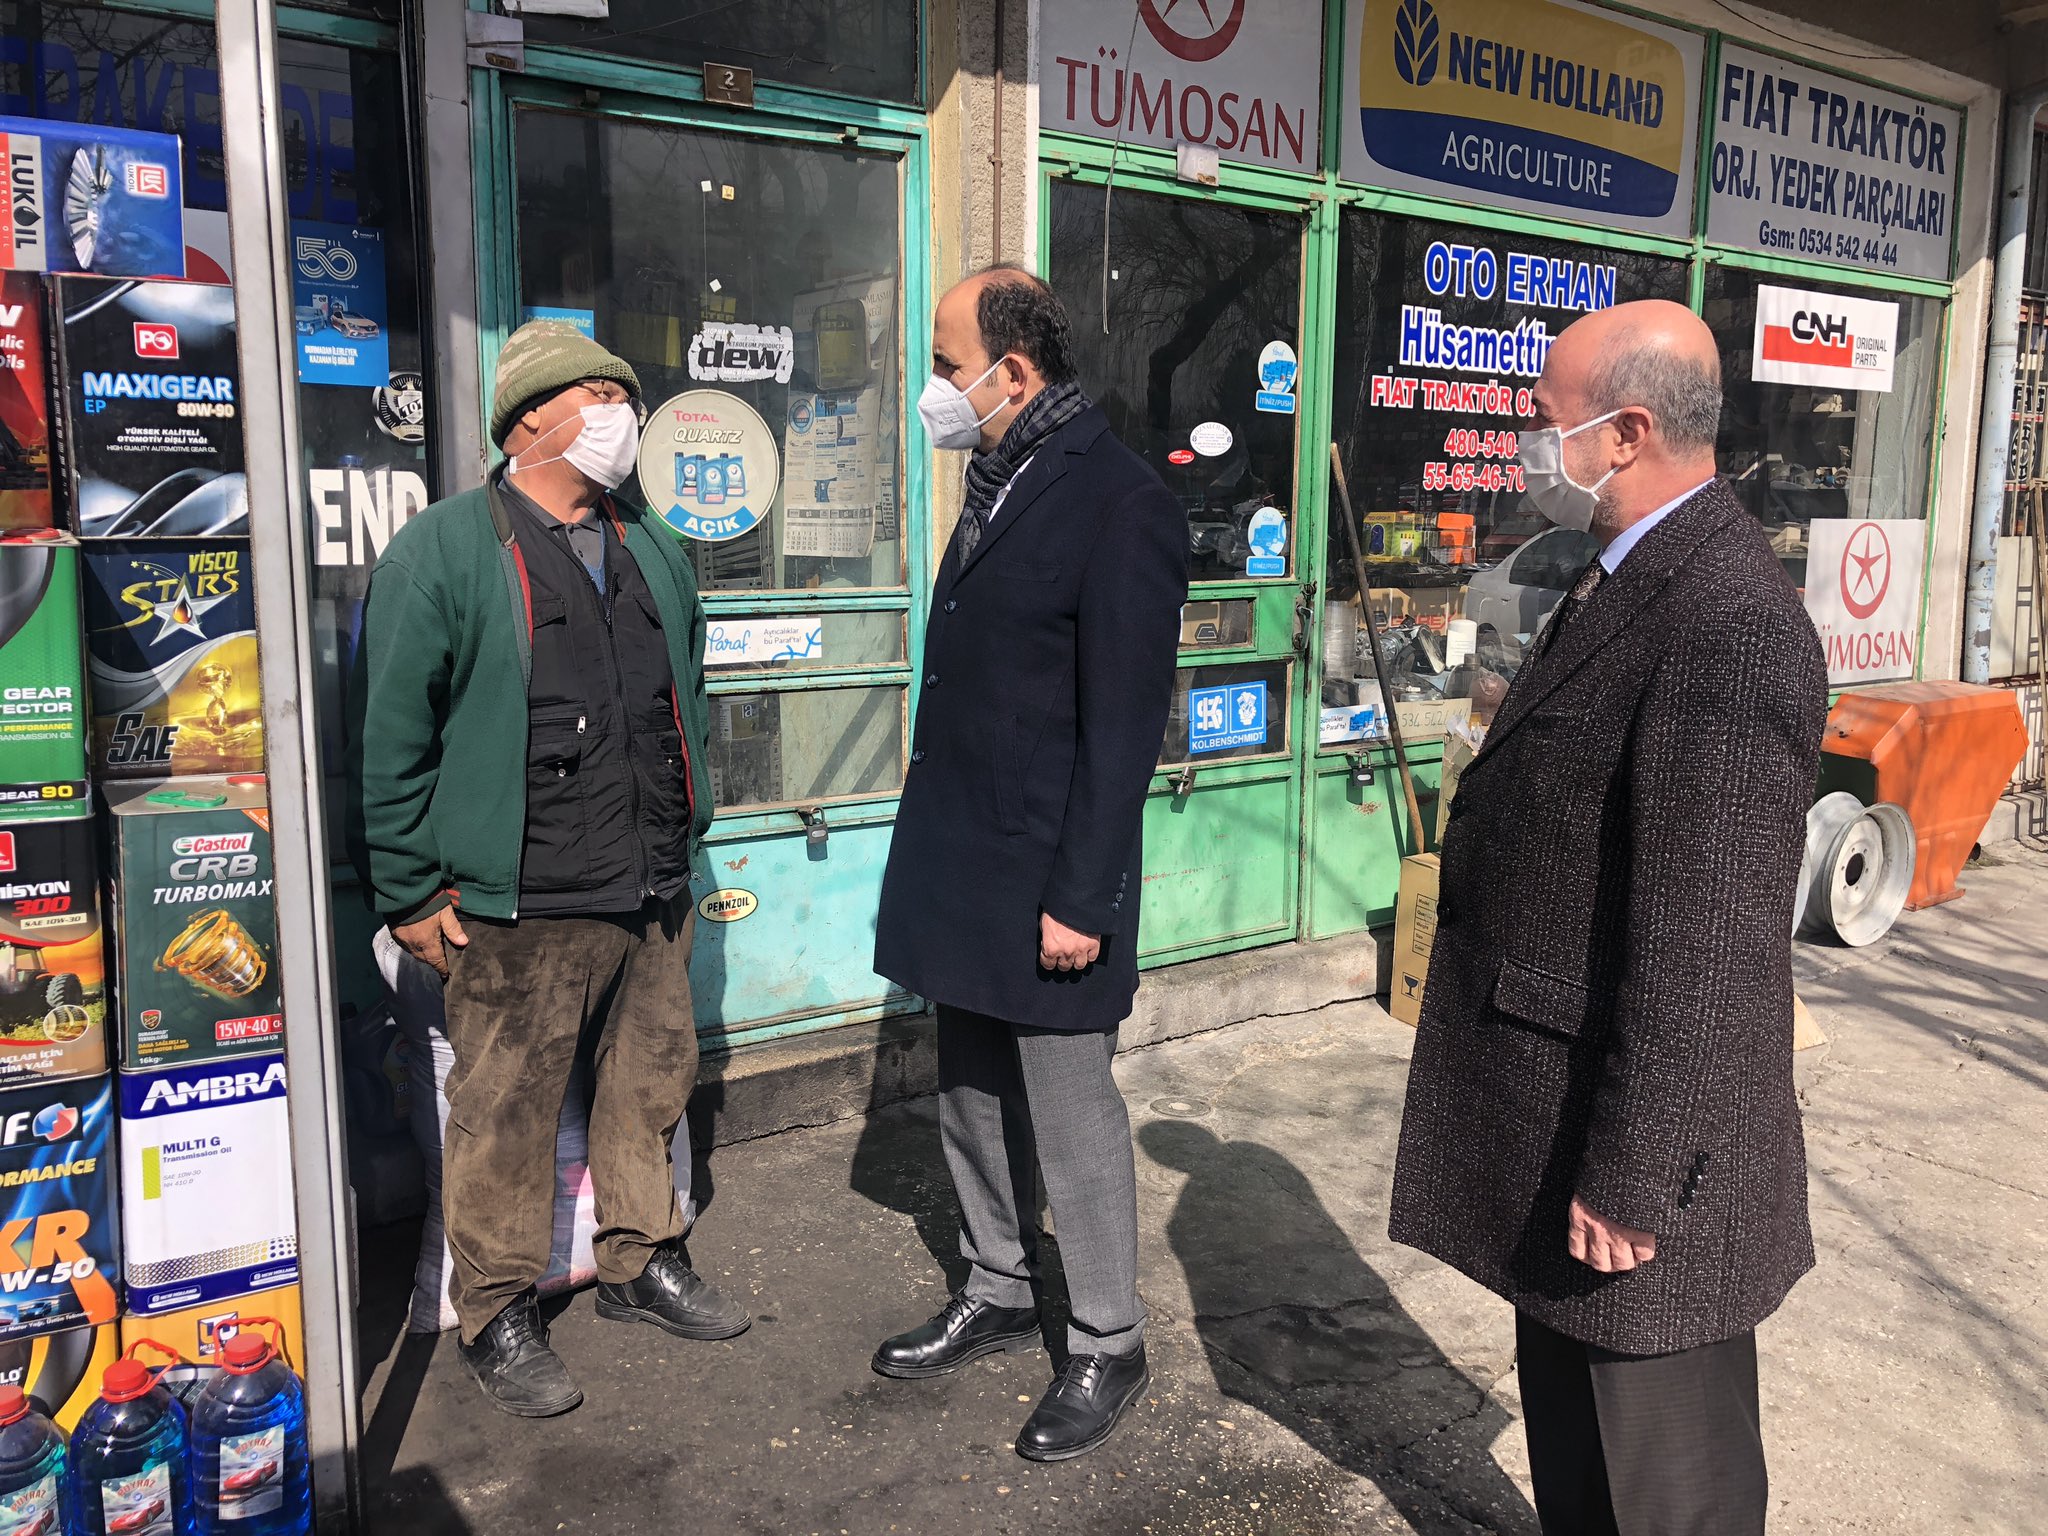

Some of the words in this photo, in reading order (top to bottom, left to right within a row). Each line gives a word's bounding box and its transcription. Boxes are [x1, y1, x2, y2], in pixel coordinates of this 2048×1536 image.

[725, 71, 735, 86] 2
[1449, 31, 1525, 96] NEW
[1530, 52, 1664, 129] HOLLAND
[1056, 46, 1305, 164] TÜMOSAN
[1722, 64, 1799, 136] FIAT
[1808, 86, 1947, 175] TRAKTÖR
[1442, 131, 1612, 198] AGRICULTURE
[1712, 141, 1761, 201] ORJ.
[1770, 153, 1839, 216] YEDEK
[1842, 170, 1946, 238] PARÇALARI
[11, 153, 42, 250] LUKOIL
[1759, 220, 1795, 250] Gsm:
[1799, 227, 1832, 256] 0534
[1835, 234, 1860, 259] 542
[1863, 239, 1879, 264] 44
[1882, 243, 1898, 267] 44
[1425, 242, 1496, 299] OTO
[1506, 252, 1616, 312] ERHAN
[1792, 311, 1847, 344] CNH
[1856, 336, 1888, 353] ORIGINAL
[698, 341, 782, 370] dew
[1855, 353, 1878, 367] PARTS
[82, 372, 234, 401] MAXIGEAR
[1371, 375, 1418, 409] FIAT
[1420, 380, 1512, 416] TRAKTÖR
[85, 400, 107, 413] EP
[177, 402, 235, 418] 80W-90
[673, 410, 720, 424] TOTAL
[674, 427, 744, 445] QUARTZ
[683, 516, 741, 537] AÇIK
[1819, 624, 1914, 672] ÜMOSAN
[4, 687, 72, 700] GEAR
[0, 702, 73, 714] ECTOR
[0, 733, 58, 741] ANSMISSION
[4, 723, 73, 732] PERFORMANCE
[107, 713, 179, 764] SAE
[1192, 731, 1264, 751] KOLBENSCHMIDT
[42, 786, 73, 798] 90
[193, 835, 248, 853] Castrol
[169, 854, 258, 881] CRB
[153, 880, 272, 905] TURBOMAX
[12, 896, 72, 917] 300
[706, 895, 750, 914] PENNZOIL
[25, 919, 43, 927] SAE
[46, 916, 82, 925] 10W-30
[218, 1018, 269, 1038] 15W-40
[0, 1064, 22, 1074] TİM
[140, 1062, 287, 1112] AMBRA
[163, 1138, 206, 1155] MULTI
[210, 1136, 221, 1147] G
[163, 1150, 218, 1163] Transmission
[220, 1146, 232, 1155] Oil
